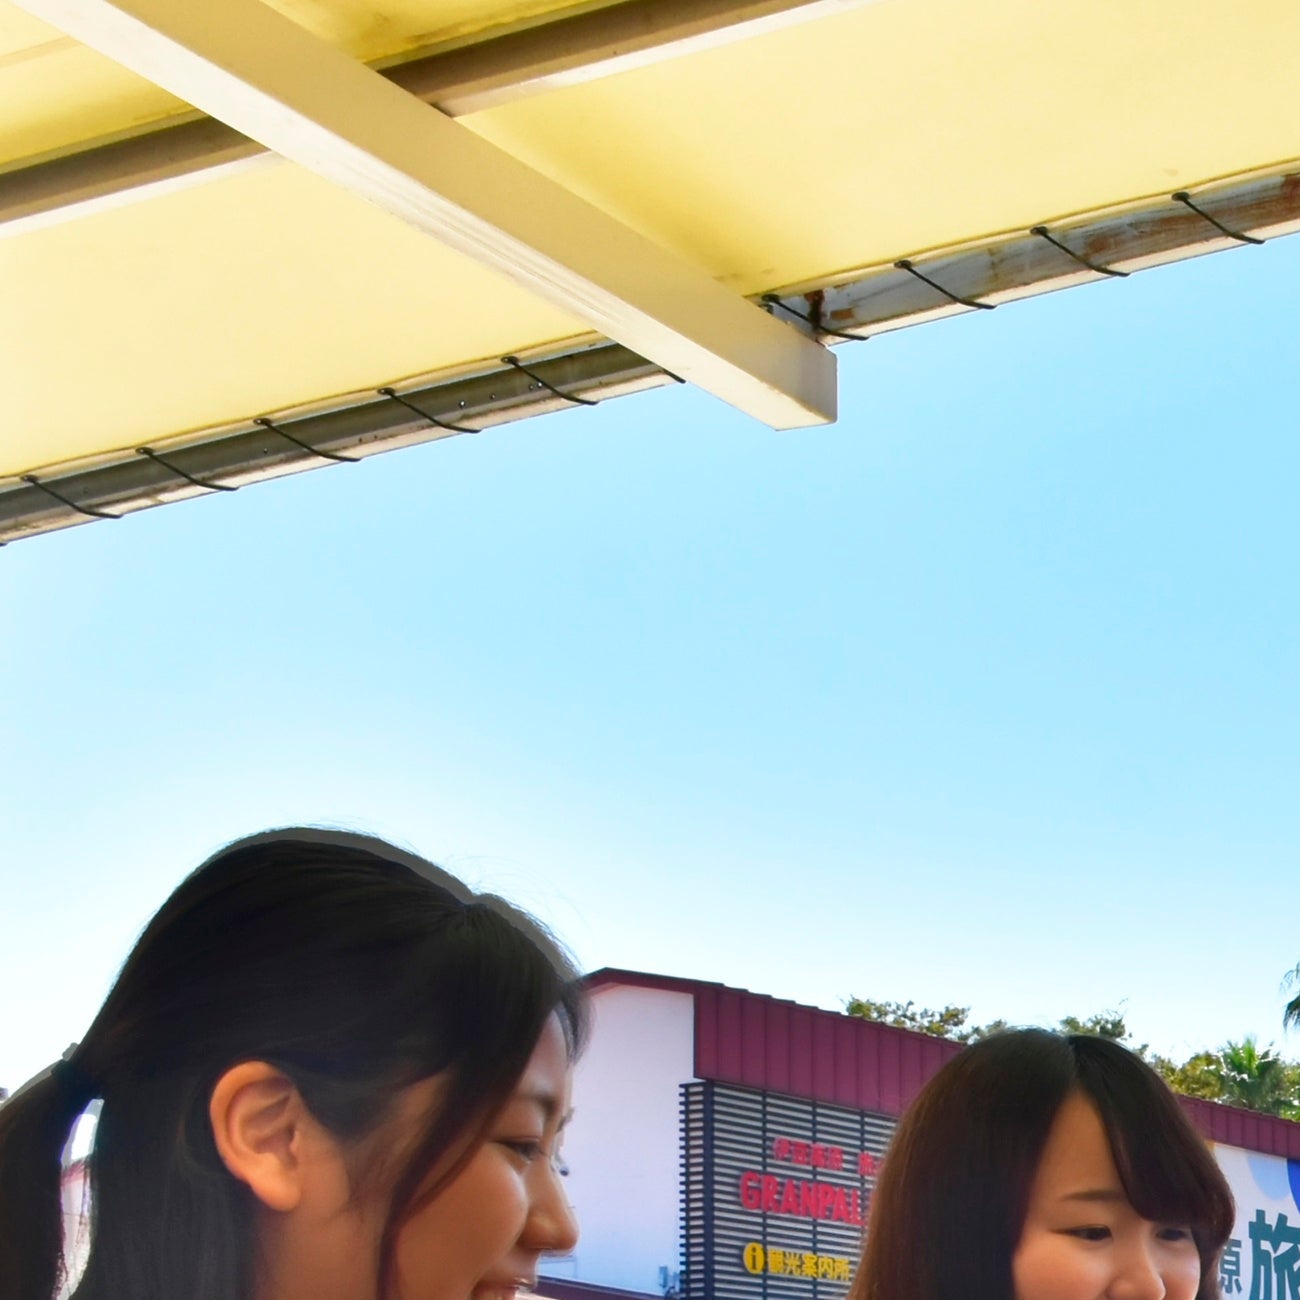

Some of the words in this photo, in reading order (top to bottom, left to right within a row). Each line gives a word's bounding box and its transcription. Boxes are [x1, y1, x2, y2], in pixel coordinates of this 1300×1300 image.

[740, 1170, 868, 1227] GRANPAL
[767, 1248, 850, 1281] 観光案内所
